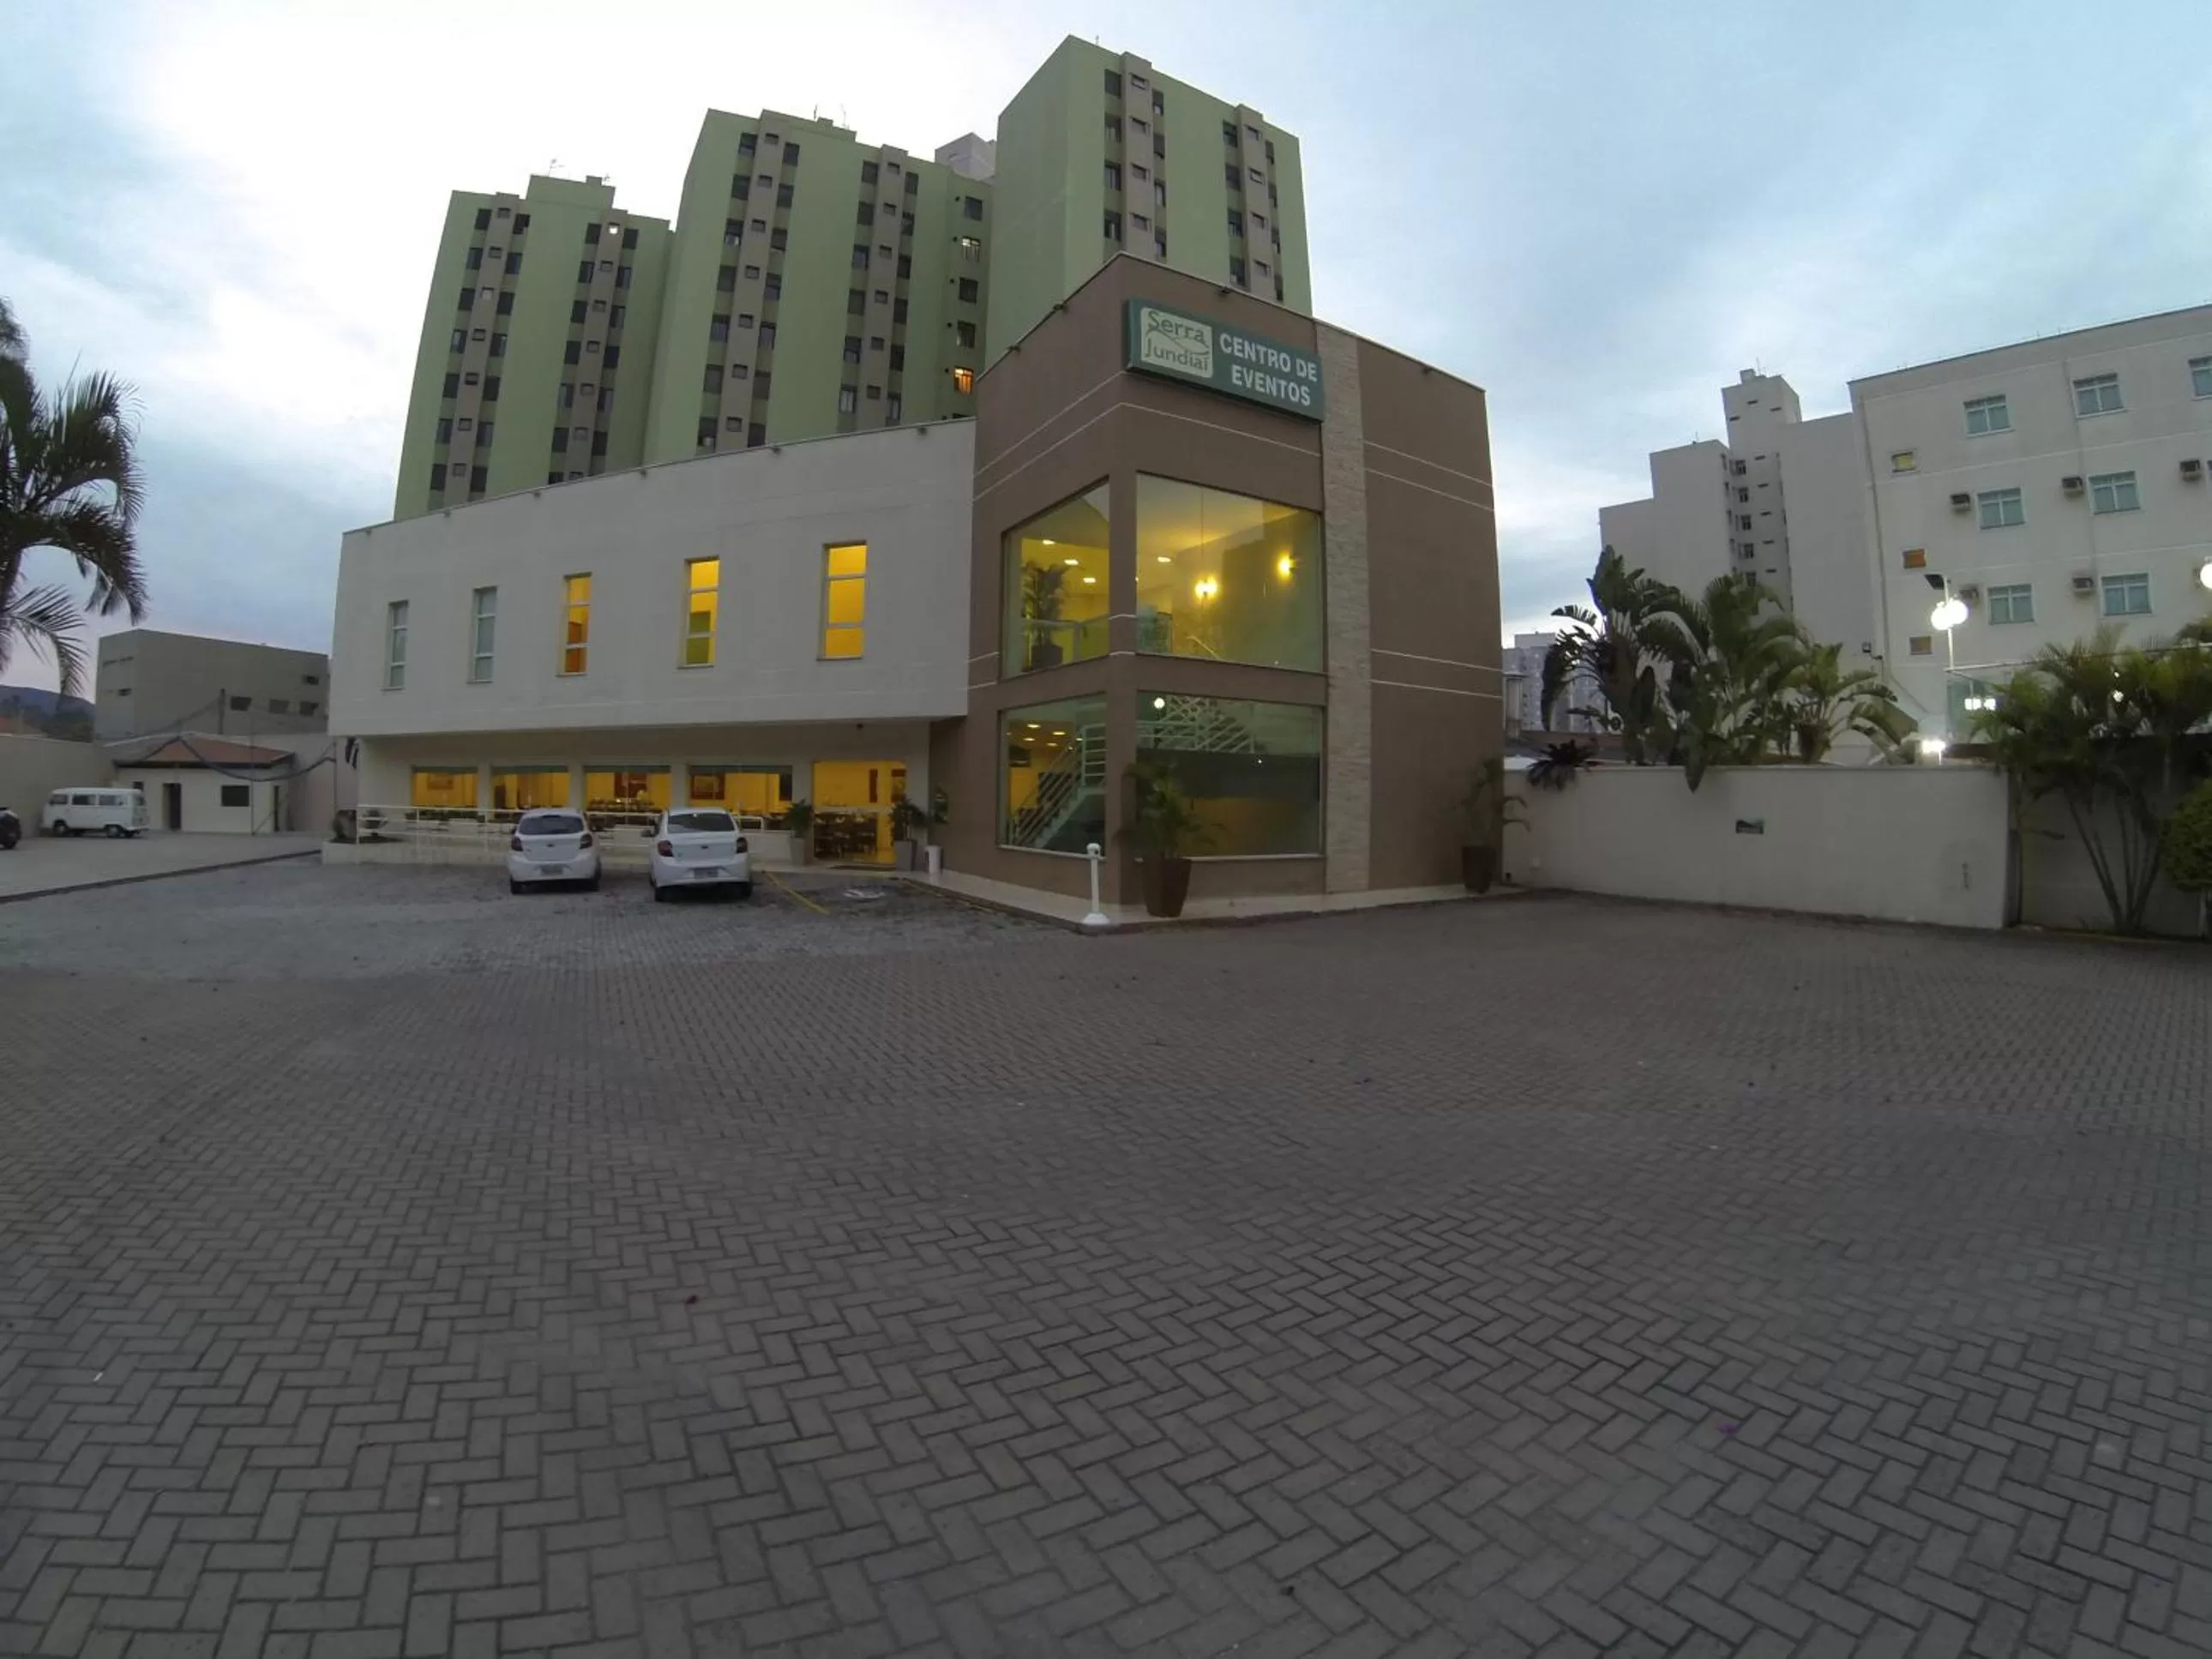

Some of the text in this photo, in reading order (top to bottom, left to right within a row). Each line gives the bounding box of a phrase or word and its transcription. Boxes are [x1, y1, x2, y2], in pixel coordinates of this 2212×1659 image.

[1148, 310, 1205, 342] Serra
[1220, 333, 1317, 382] CENTRO DE
[1232, 364, 1310, 406] EVENTOS
